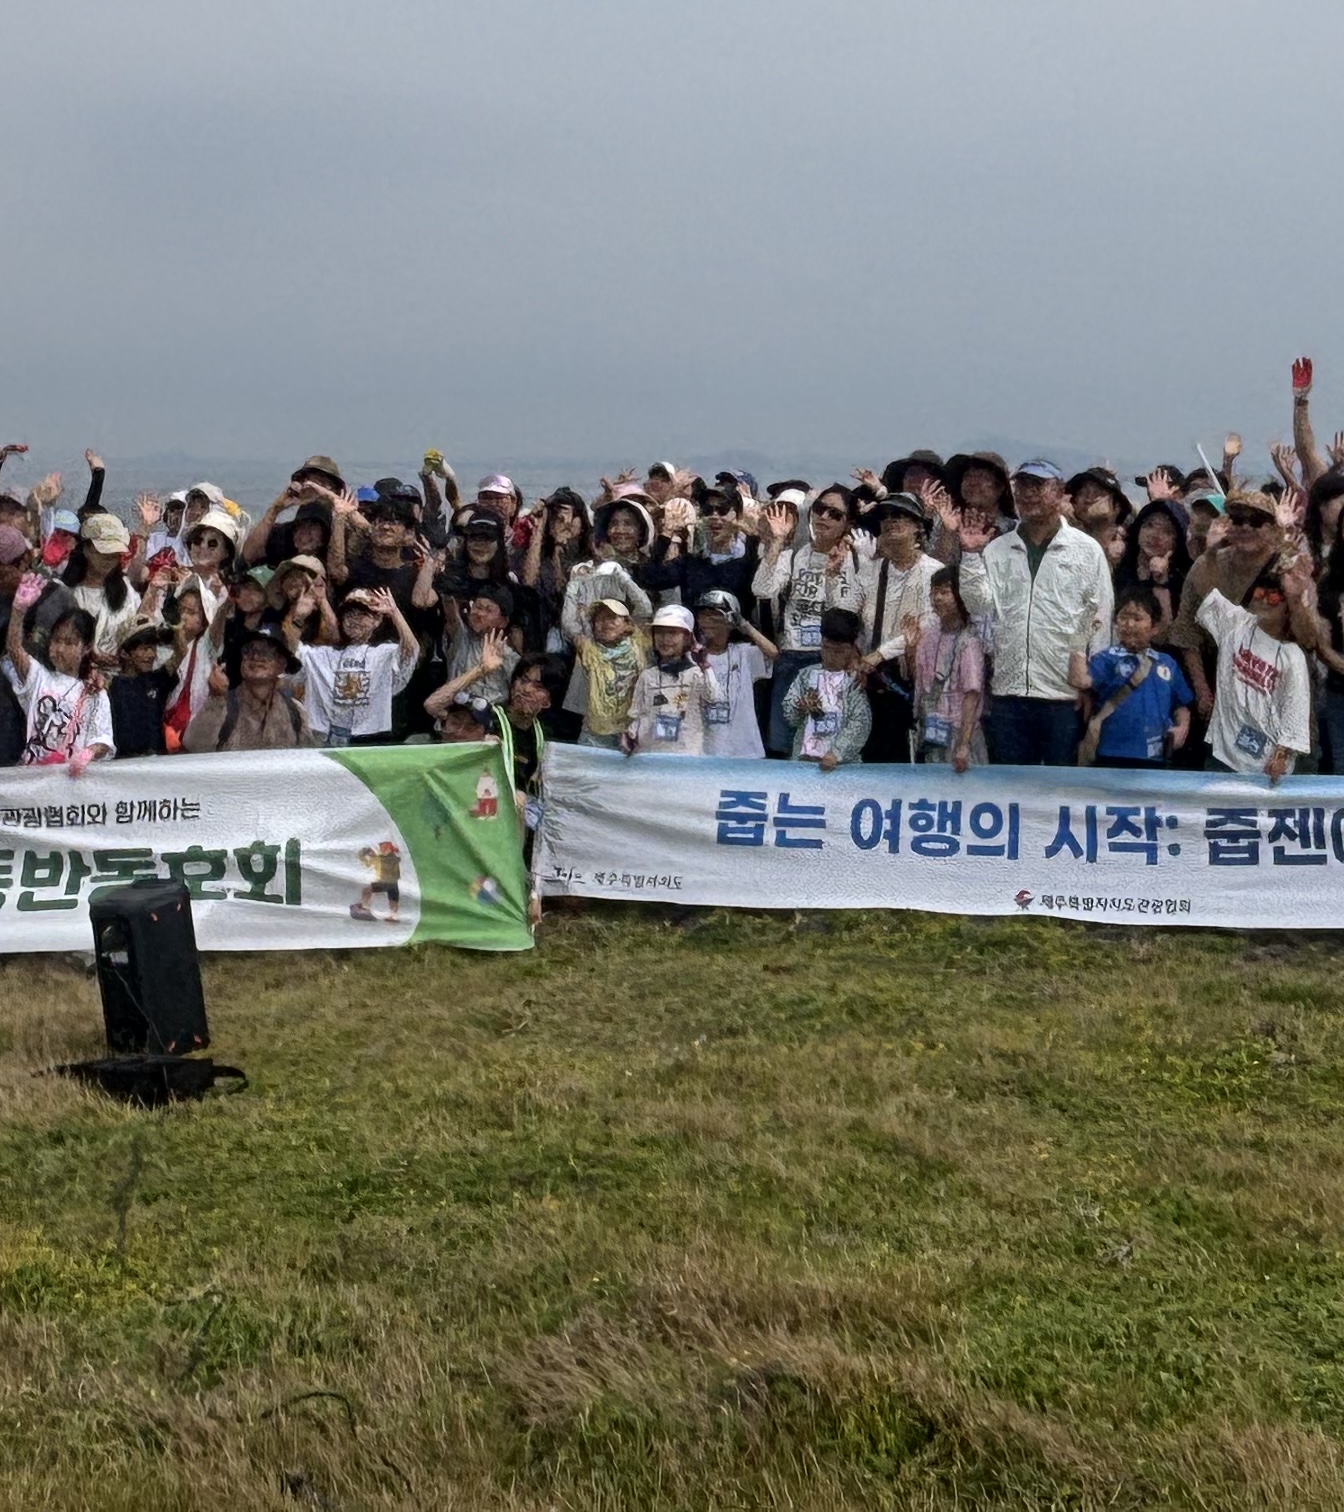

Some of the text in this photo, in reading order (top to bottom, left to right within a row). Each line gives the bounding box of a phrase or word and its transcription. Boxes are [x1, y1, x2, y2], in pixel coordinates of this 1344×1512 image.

[115, 797, 201, 825] 함께하는
[715, 789, 827, 850] 줍는
[850, 798, 1019, 861] 여행의
[1044, 805, 1181, 864] 시작:
